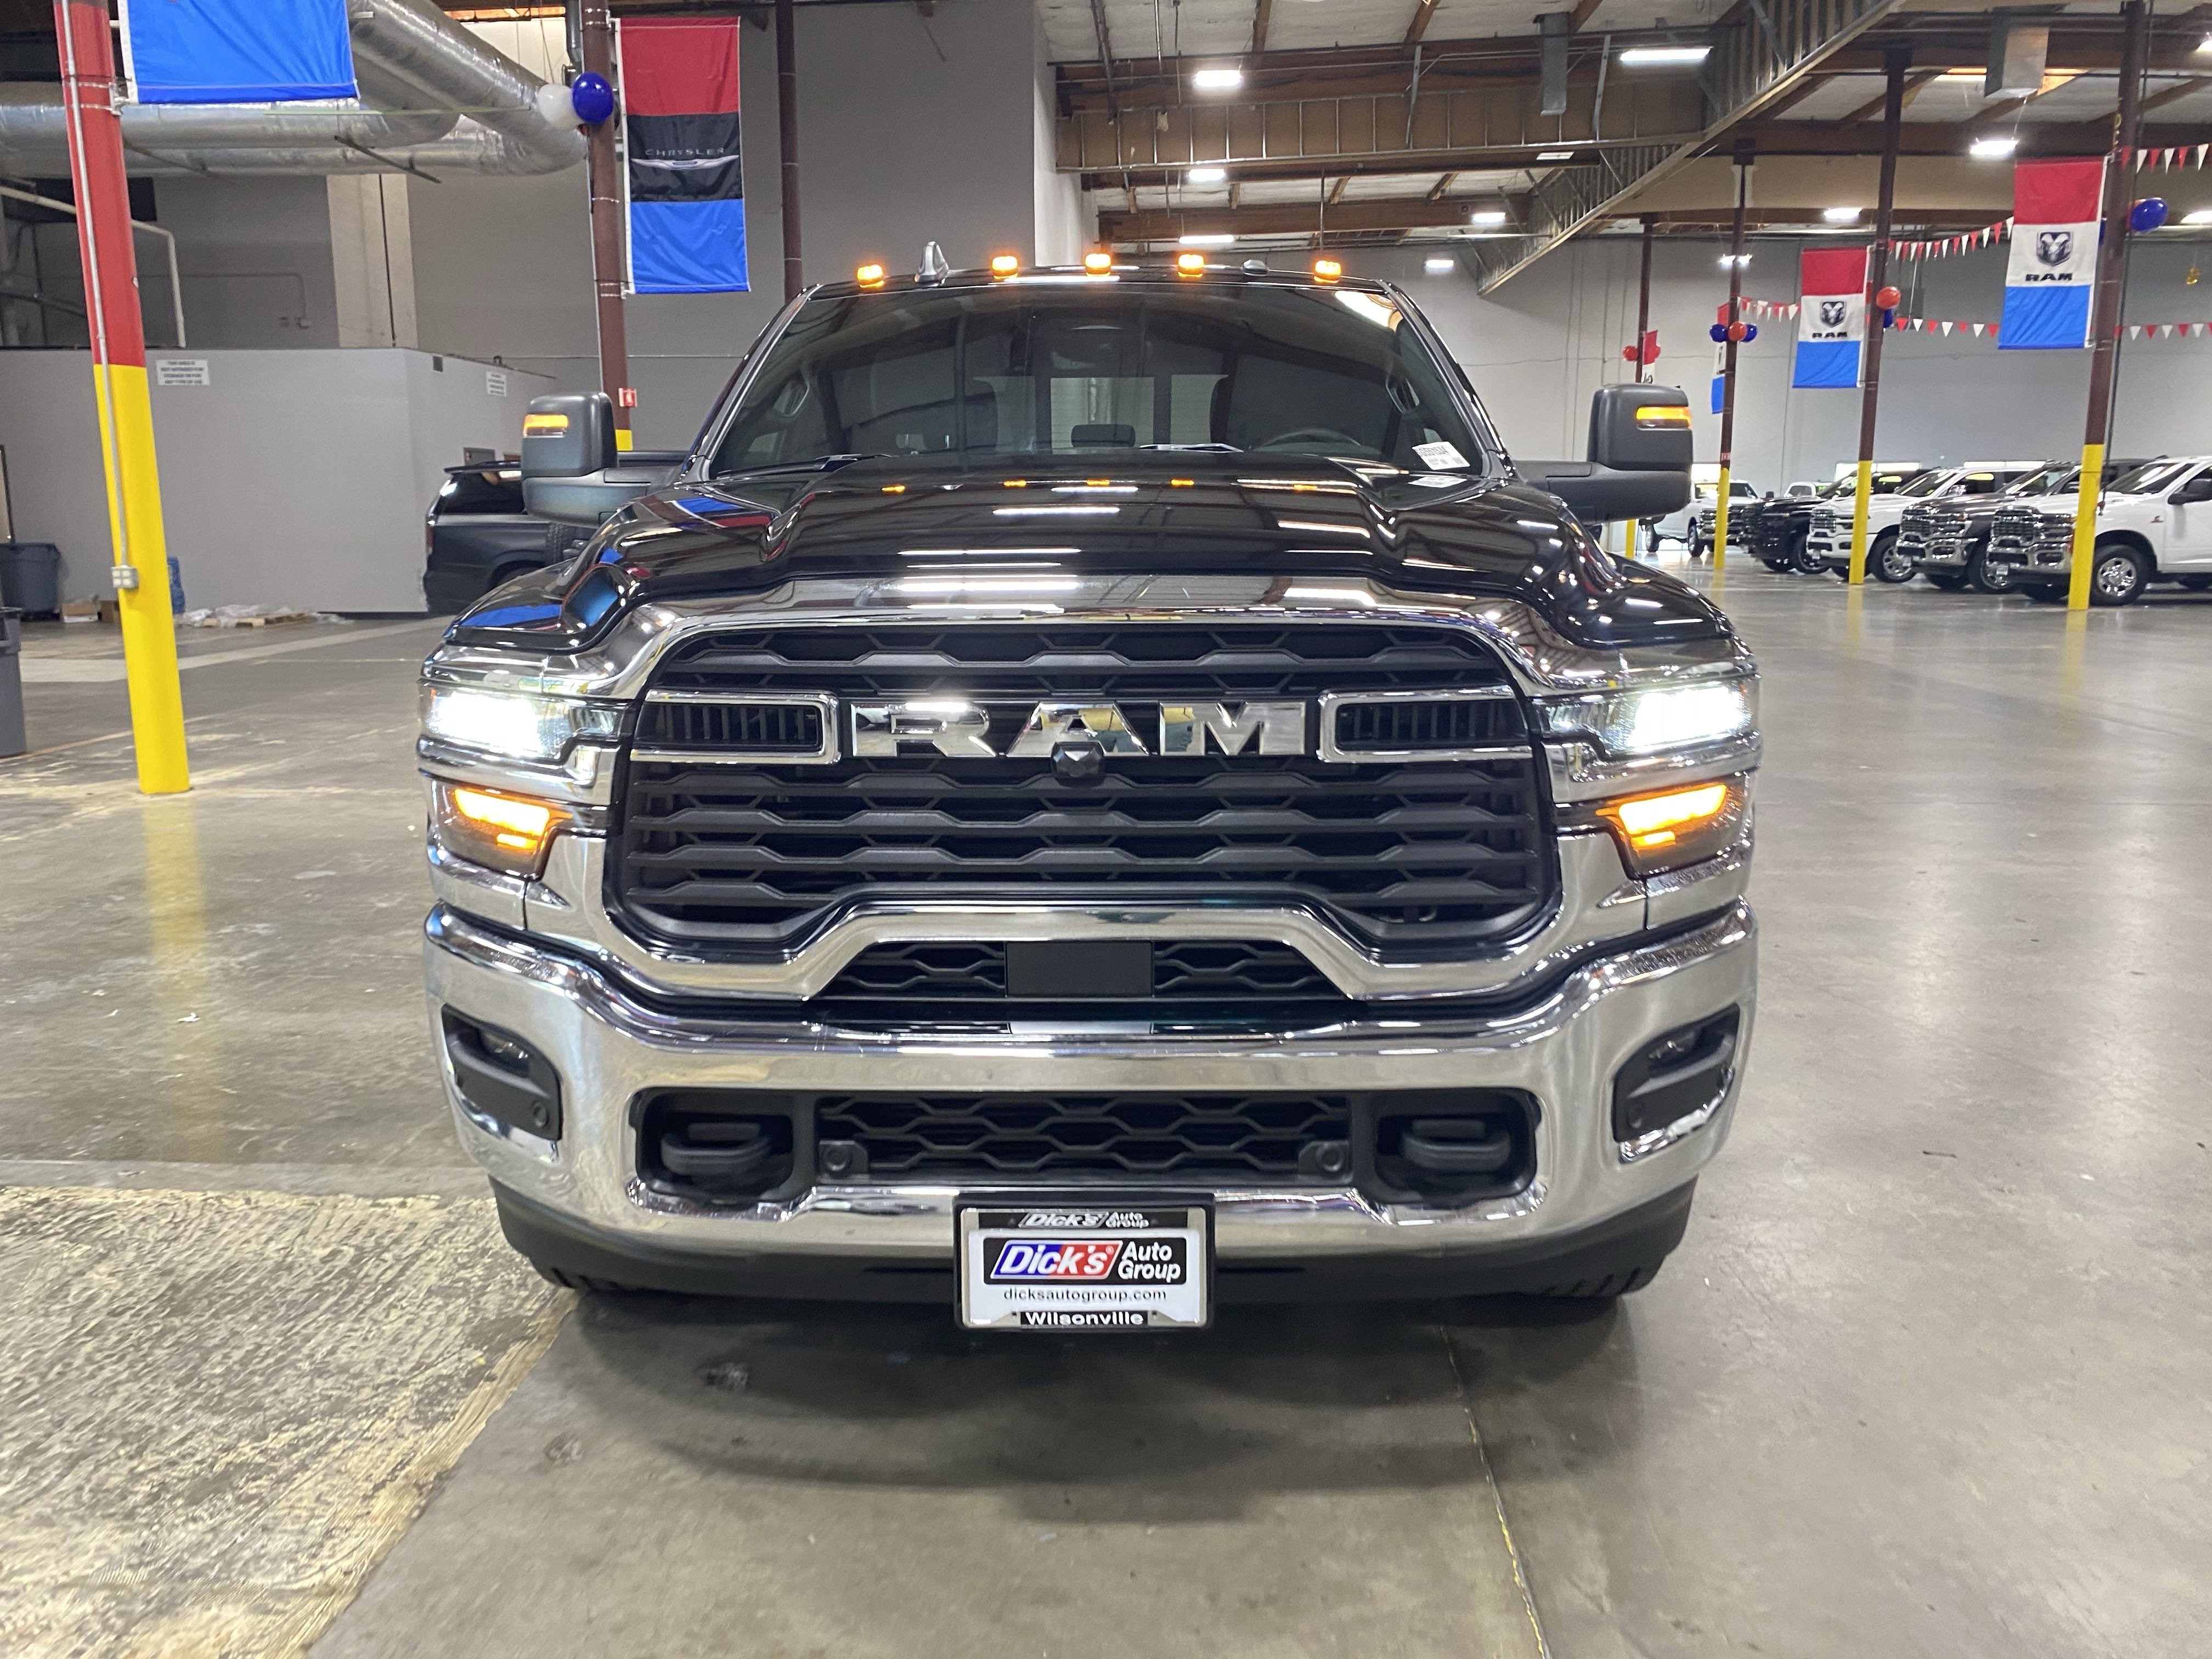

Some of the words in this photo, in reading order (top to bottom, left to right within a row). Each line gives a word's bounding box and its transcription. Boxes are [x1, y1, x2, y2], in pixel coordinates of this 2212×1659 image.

[645, 148, 725, 156] CHRYSLER
[2025, 273, 2073, 281] RAM
[850, 701, 1306, 757] RAM
[1025, 1213, 1099, 1227] Dick's
[1000, 1244, 1108, 1274] Dick's
[1122, 1242, 1172, 1261] Auto
[1118, 1260, 1181, 1283] Group
[1003, 1287, 1167, 1303] dicksautogroup.com
[1025, 1312, 1144, 1325] Wilsonville
